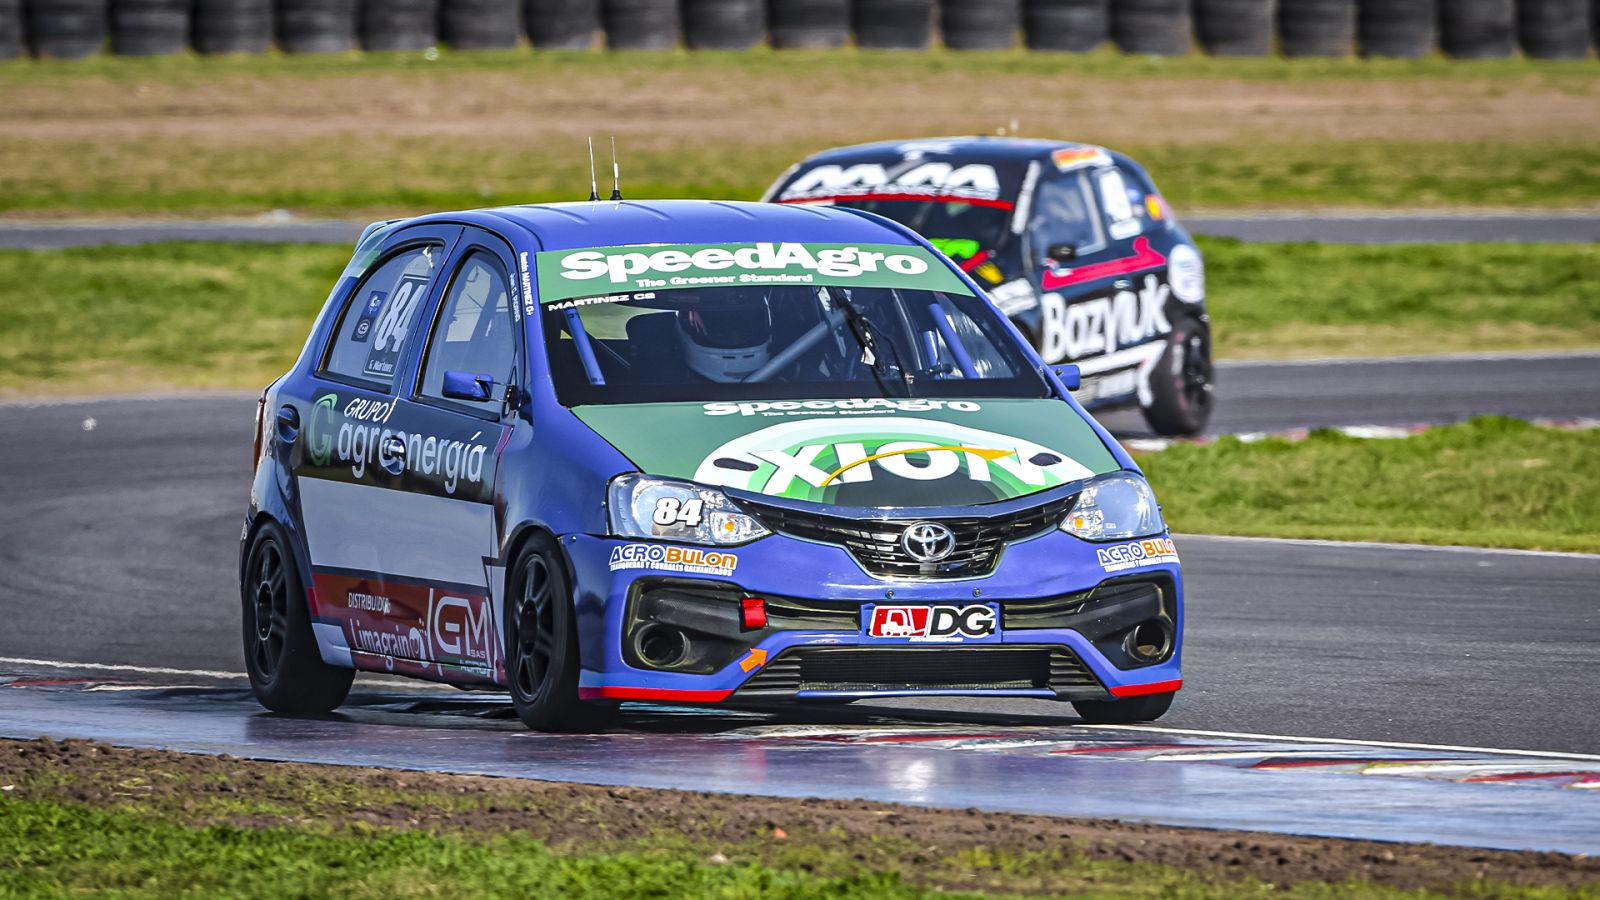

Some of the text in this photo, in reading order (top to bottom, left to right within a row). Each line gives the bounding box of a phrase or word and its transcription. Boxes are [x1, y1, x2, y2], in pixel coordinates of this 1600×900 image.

[560, 242, 928, 283] SpeedAgro
[636, 273, 813, 288] The Greener Standard
[374, 281, 428, 353] 84
[548, 295, 630, 311] MARTINEZ
[343, 398, 389, 424] GRUPO
[703, 398, 981, 416] SpeedAgro
[652, 497, 704, 528] 84
[929, 604, 996, 638] DG
